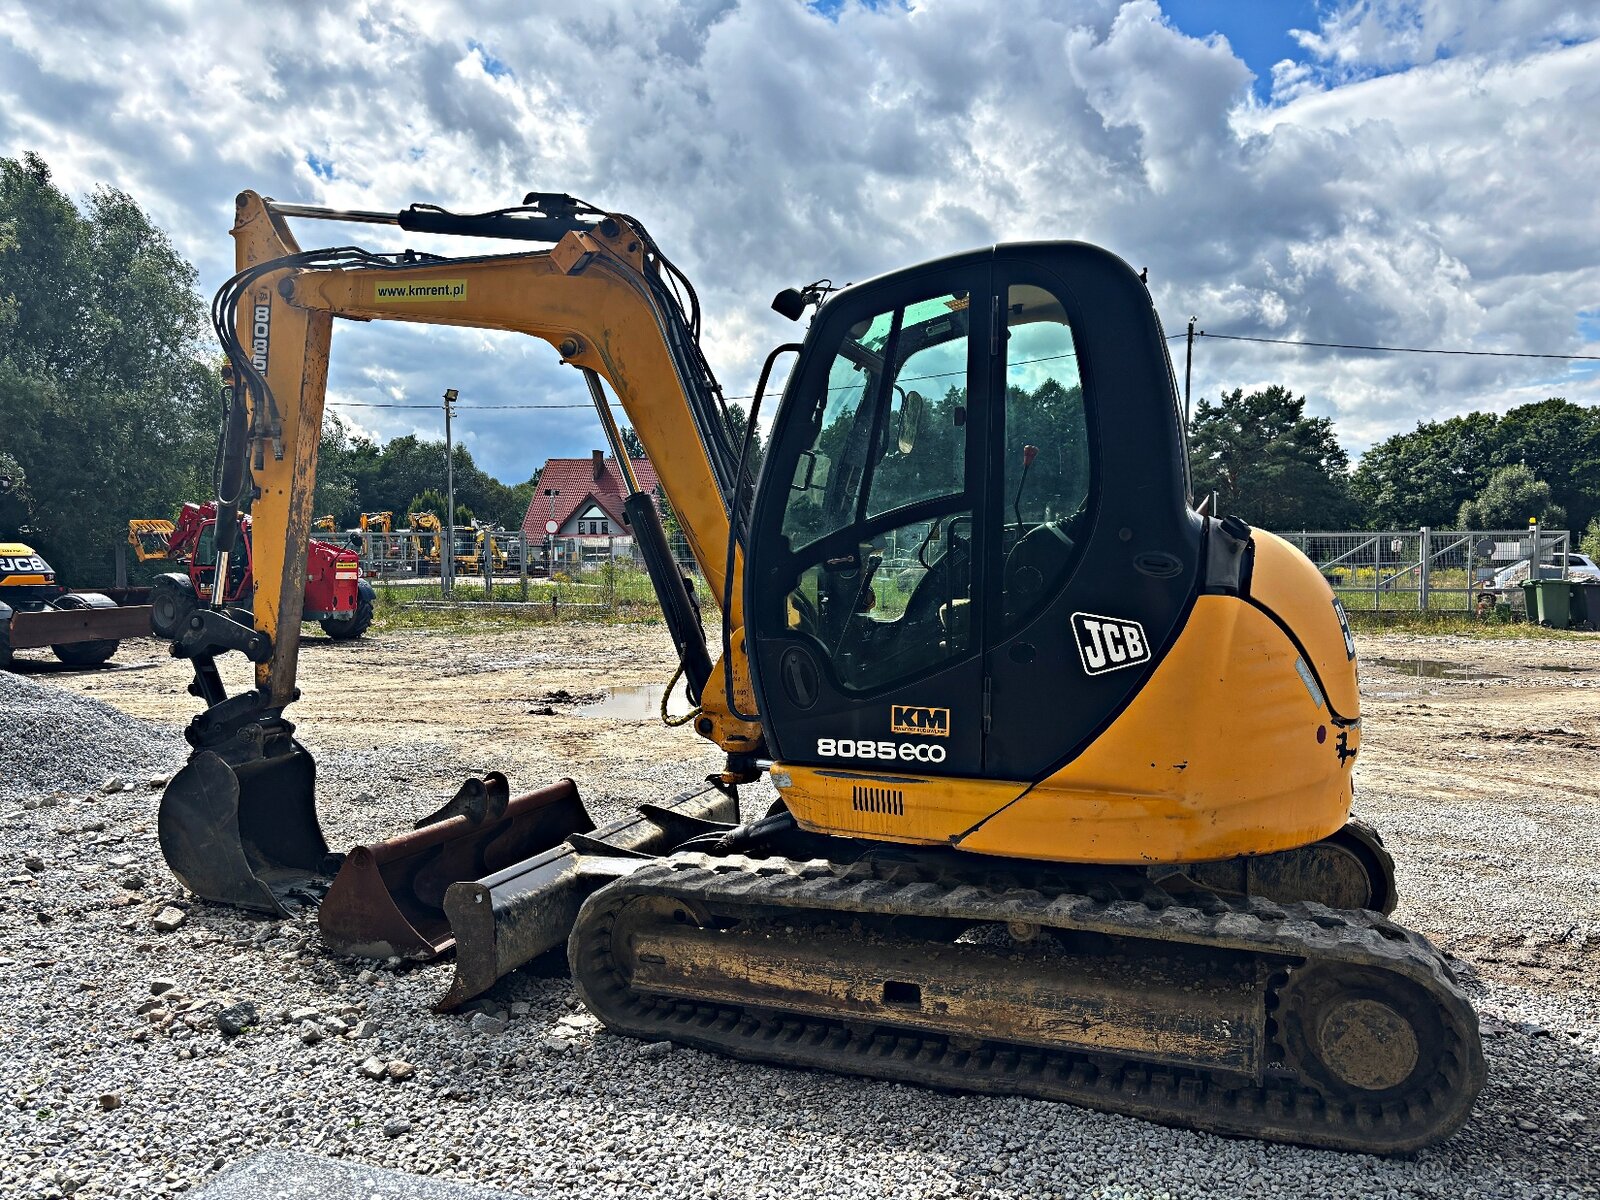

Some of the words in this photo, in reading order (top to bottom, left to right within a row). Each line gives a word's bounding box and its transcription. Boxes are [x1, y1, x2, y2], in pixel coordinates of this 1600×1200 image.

[378, 284, 464, 297] www.kmrent.pl
[0, 557, 46, 571] JCB
[1083, 619, 1144, 668] JCB
[893, 707, 947, 729] KM
